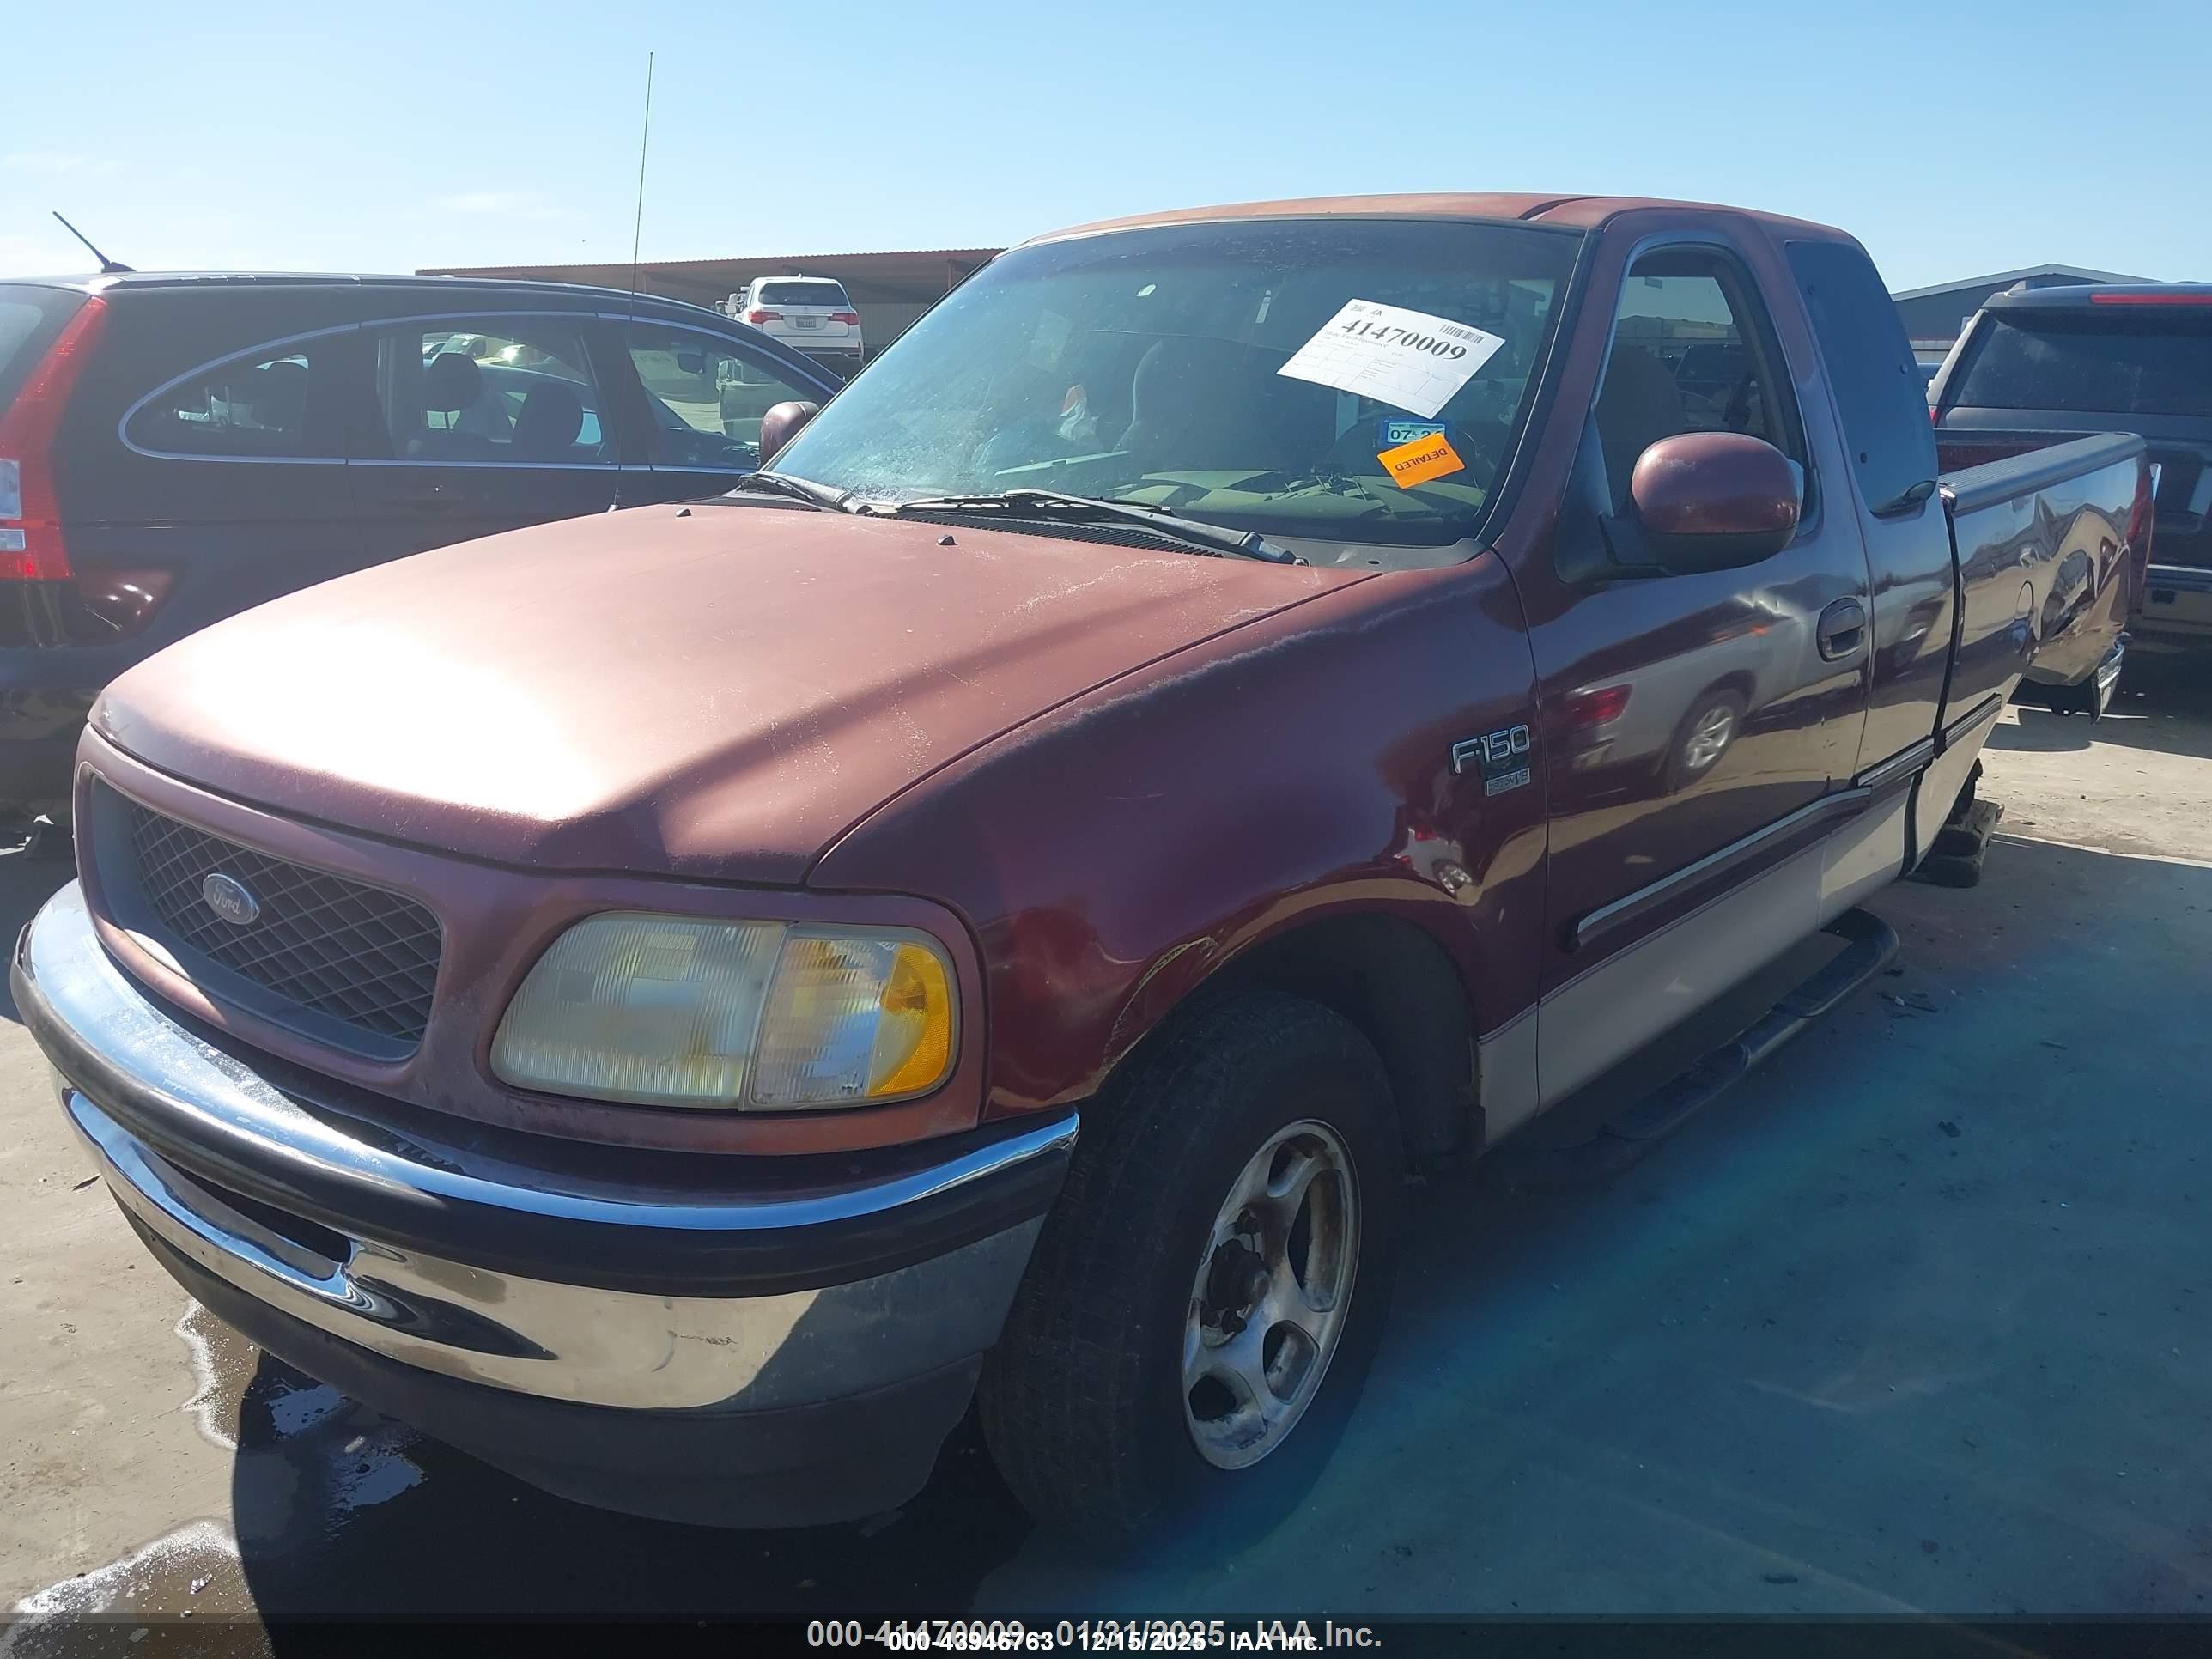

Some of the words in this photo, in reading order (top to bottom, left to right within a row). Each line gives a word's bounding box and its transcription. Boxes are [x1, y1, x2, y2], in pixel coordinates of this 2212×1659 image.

[1341, 319, 1468, 362] 41470009
[1390, 429, 1411, 440] 07
[1420, 430, 1441, 439] 2
[1395, 447, 1449, 471] DETAILED
[213, 882, 241, 915] Ford
